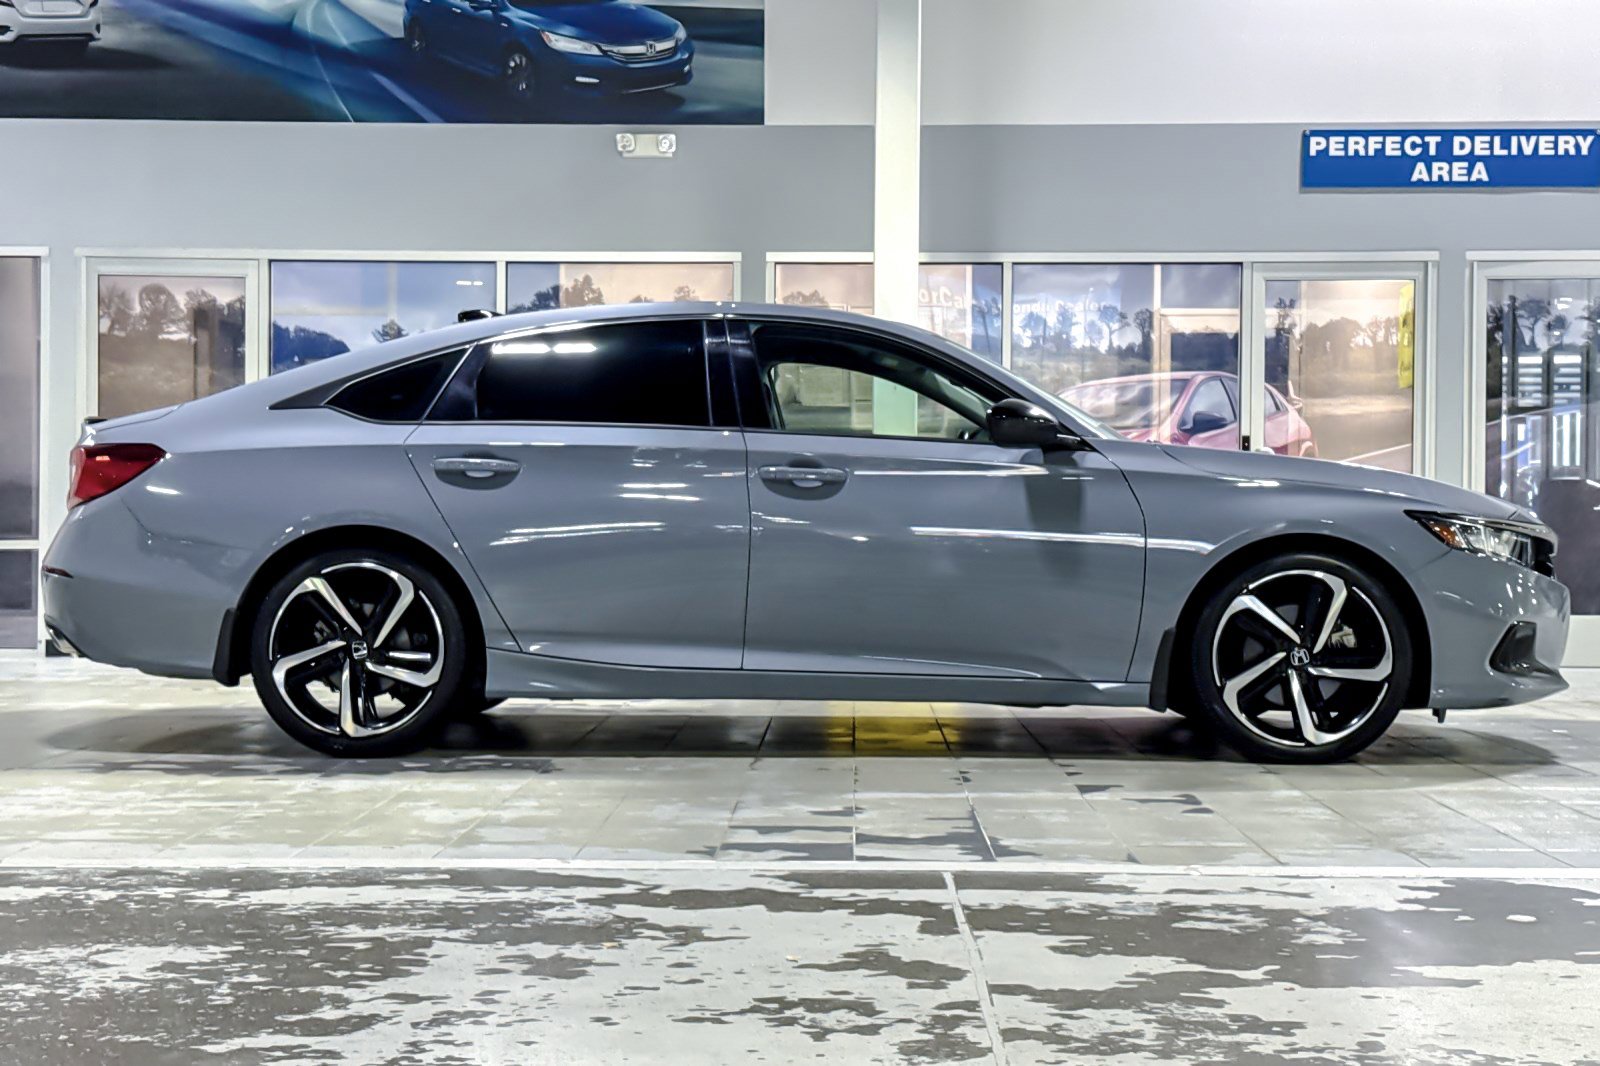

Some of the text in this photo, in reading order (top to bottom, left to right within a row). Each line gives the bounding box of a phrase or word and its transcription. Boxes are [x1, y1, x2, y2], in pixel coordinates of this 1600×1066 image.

[1309, 135, 1595, 157] PERFECT DELIVERY
[1410, 161, 1489, 182] AREA
